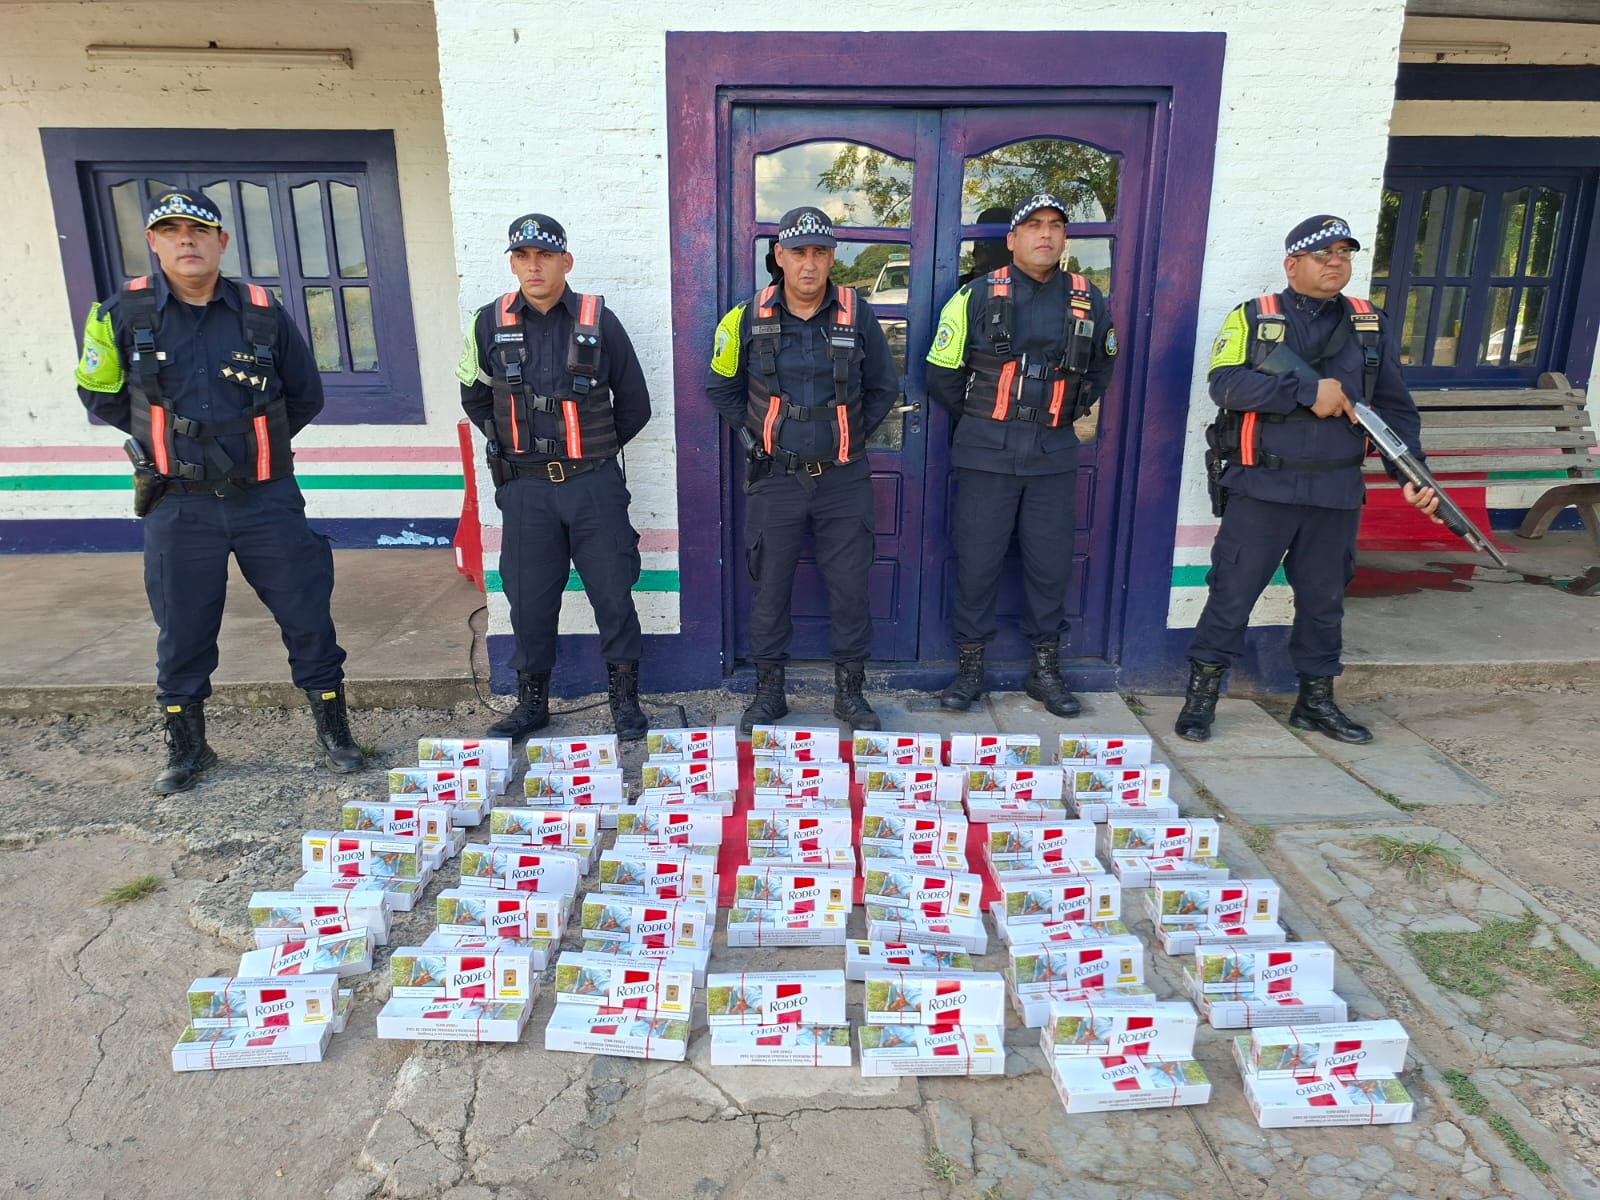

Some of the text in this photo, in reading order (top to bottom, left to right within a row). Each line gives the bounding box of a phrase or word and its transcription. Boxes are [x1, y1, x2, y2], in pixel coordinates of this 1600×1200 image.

[432, 780, 460, 793] RODEO
[537, 823, 567, 836] RODEO
[664, 823, 693, 835] RODEO
[794, 828, 823, 840] RODEO
[1038, 837, 1068, 852] RODEO
[333, 851, 365, 862] RODEO
[511, 867, 545, 879] RODEO
[650, 874, 683, 886] RODEO
[788, 888, 821, 901] RODEO
[916, 890, 950, 901] RODEO
[1058, 896, 1090, 913] RODEO
[310, 914, 346, 927] RODEO
[492, 912, 526, 926] RODEO
[637, 921, 672, 934] RODEO
[272, 948, 310, 970] RODEO
[1073, 960, 1110, 978] RODEO
[1261, 964, 1299, 981] RODEO
[453, 970, 492, 987] RODEO
[617, 983, 655, 998] RODEO
[255, 1001, 295, 1017] RODEO
[769, 995, 808, 1013] RODEO
[928, 994, 967, 1011] RODEO
[924, 1033, 963, 1047] RODEO
[1117, 1029, 1159, 1045] RODEO
[1324, 1050, 1367, 1067] RODEO
[1102, 1064, 1140, 1081] RODEO
[1295, 1081, 1336, 1097] RODEO
